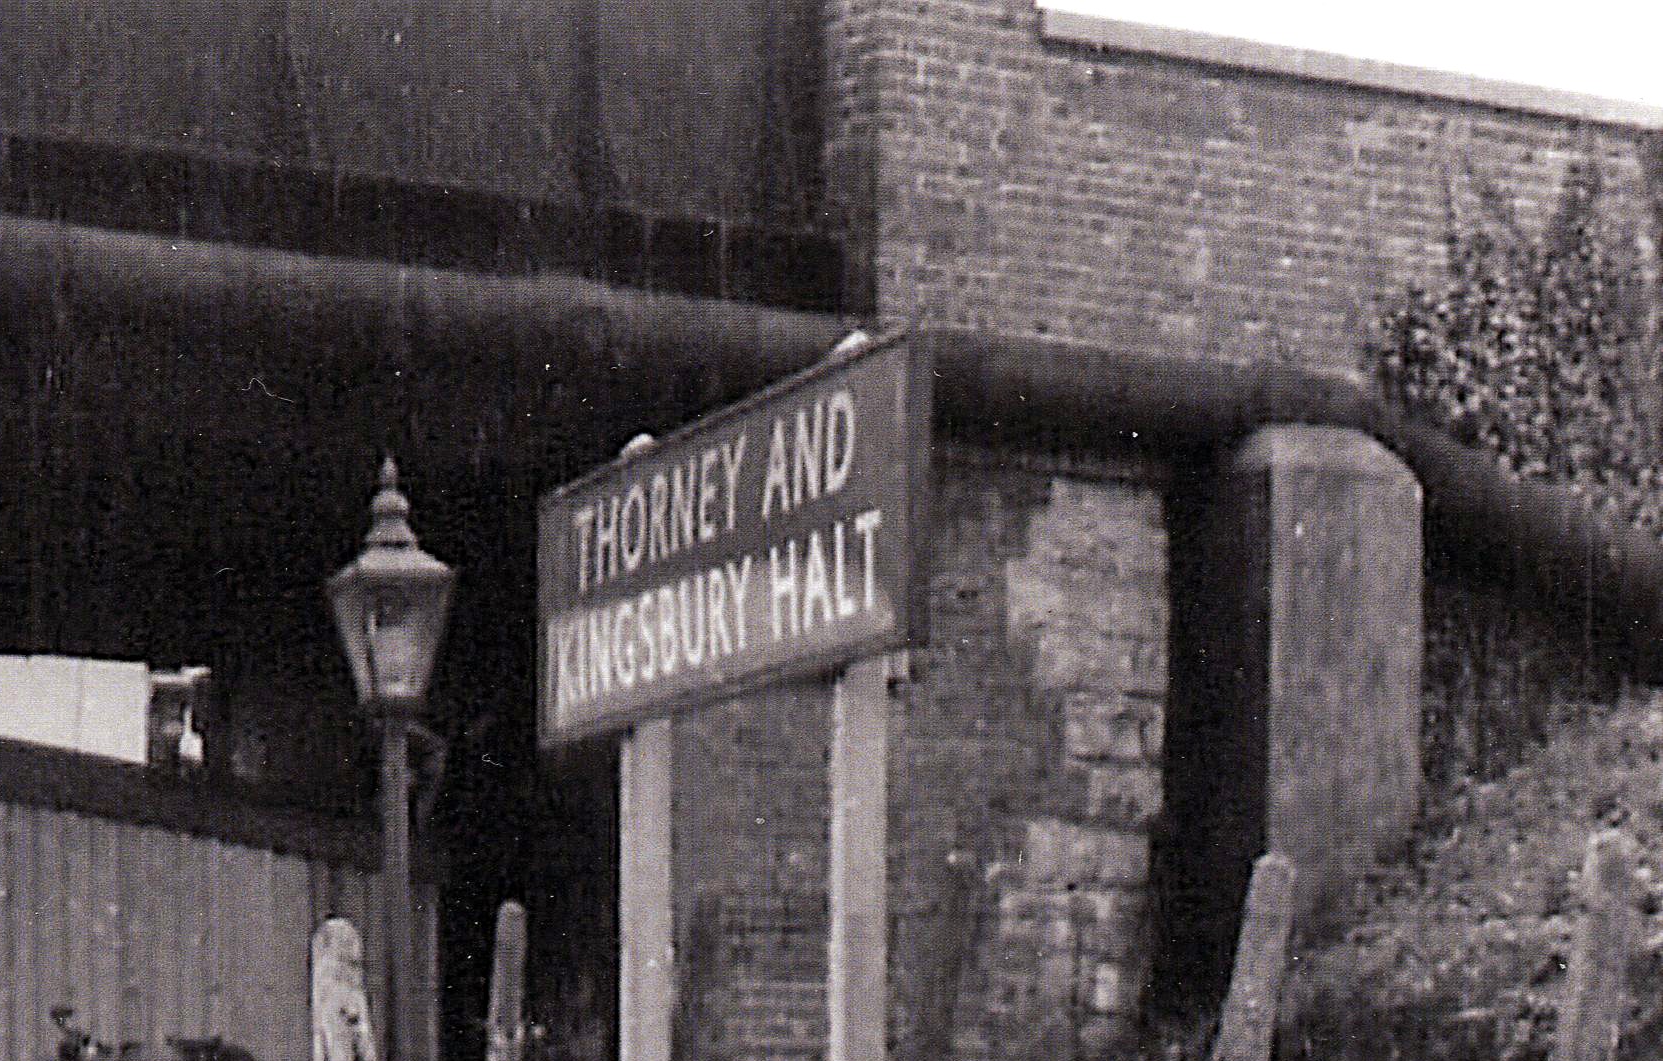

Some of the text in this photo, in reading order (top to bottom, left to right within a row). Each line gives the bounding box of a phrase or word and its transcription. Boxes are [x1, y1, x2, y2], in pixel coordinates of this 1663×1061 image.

[574, 391, 855, 594] THORNEY AND
[554, 509, 882, 714] KINGSBURY HALT
